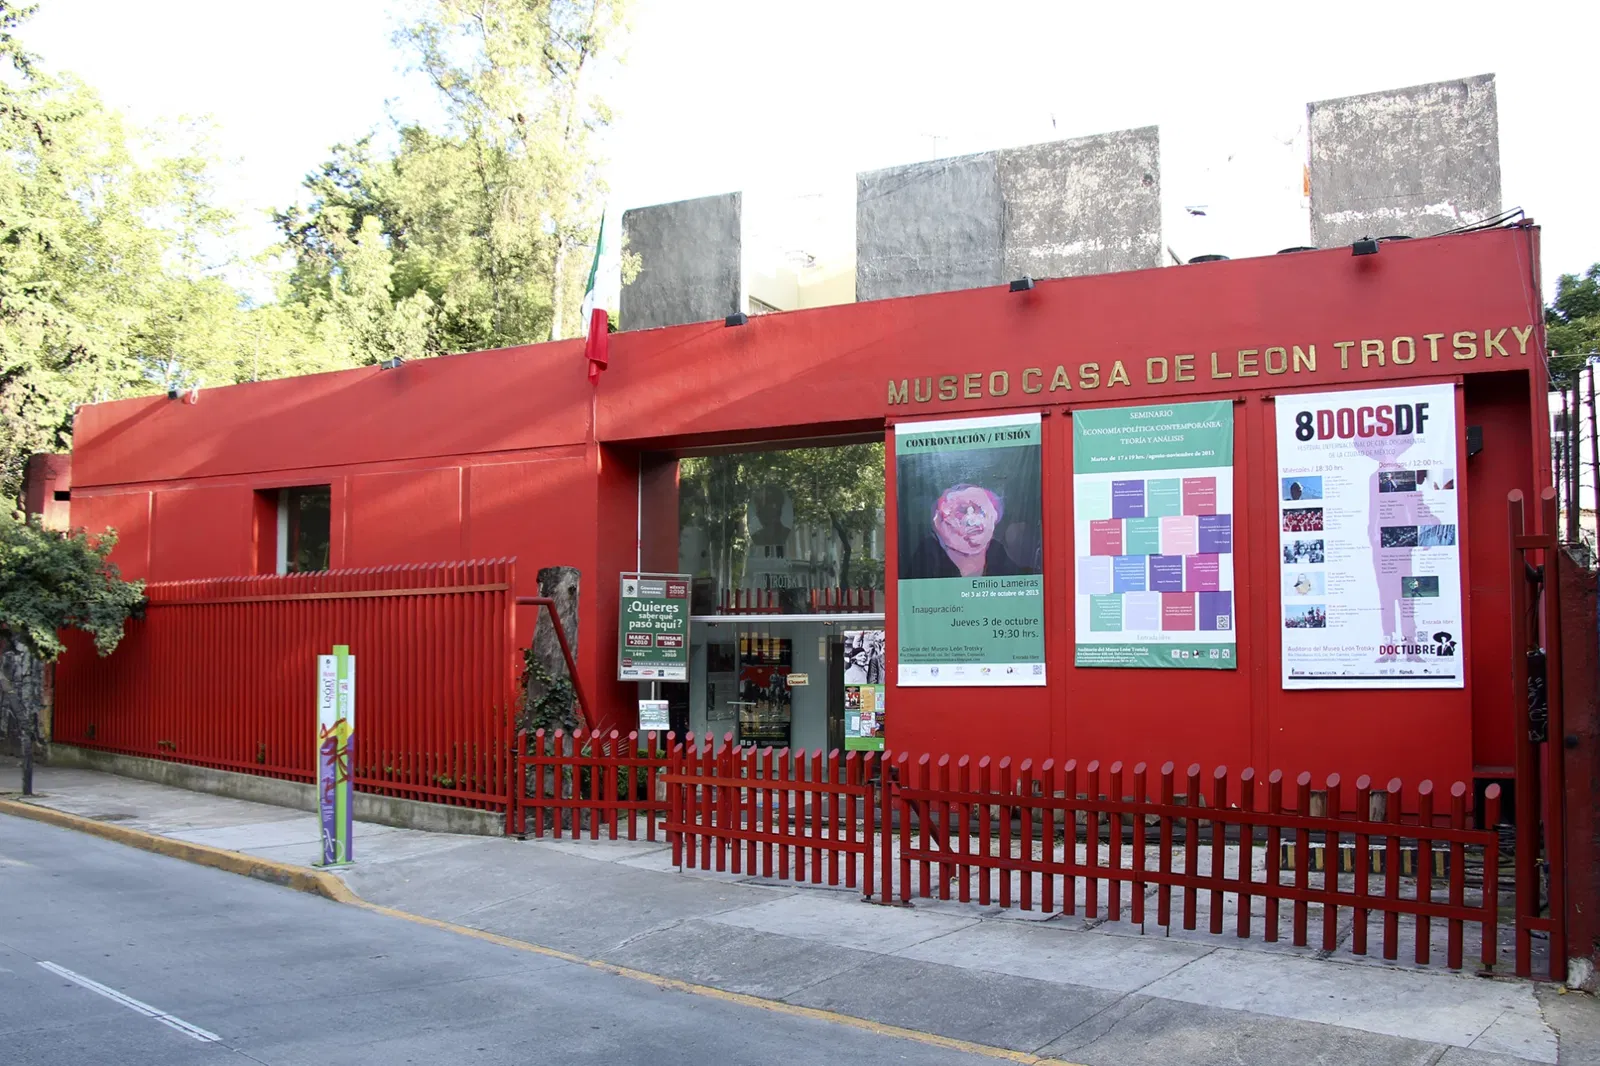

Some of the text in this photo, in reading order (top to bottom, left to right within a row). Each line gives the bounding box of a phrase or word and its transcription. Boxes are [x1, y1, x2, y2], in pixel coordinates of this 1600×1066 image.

[887, 324, 1534, 405] MUSEO CASA DE LEON TROTSKY
[1130, 410, 1173, 419] SEMINARIO
[1295, 403, 1429, 441] 8DOCSDF
[1083, 426, 1121, 435] ECONOMÍA
[1122, 424, 1155, 433] POLÍTICA
[906, 429, 1031, 448] CONFRONTACIÓN / FUSIÓN
[1120, 437, 1147, 445] TEORÍA
[1152, 434, 1184, 443] ANÁLISIS
[972, 579, 1039, 589] Emilio Lameiras
[627, 600, 679, 613] ¿Quieres
[912, 605, 964, 615] Inauguración:
[638, 612, 673, 621] saber qué
[629, 619, 683, 632] pasó aquí?
[951, 617, 1039, 627] Jueves 3 de octubre
[992, 629, 1039, 639] 19:30 hrs.
[963, 645, 983, 653] Trotsky
[1356, 645, 1375, 653] Trotsky
[1379, 644, 1436, 655] DOCTUBRE
